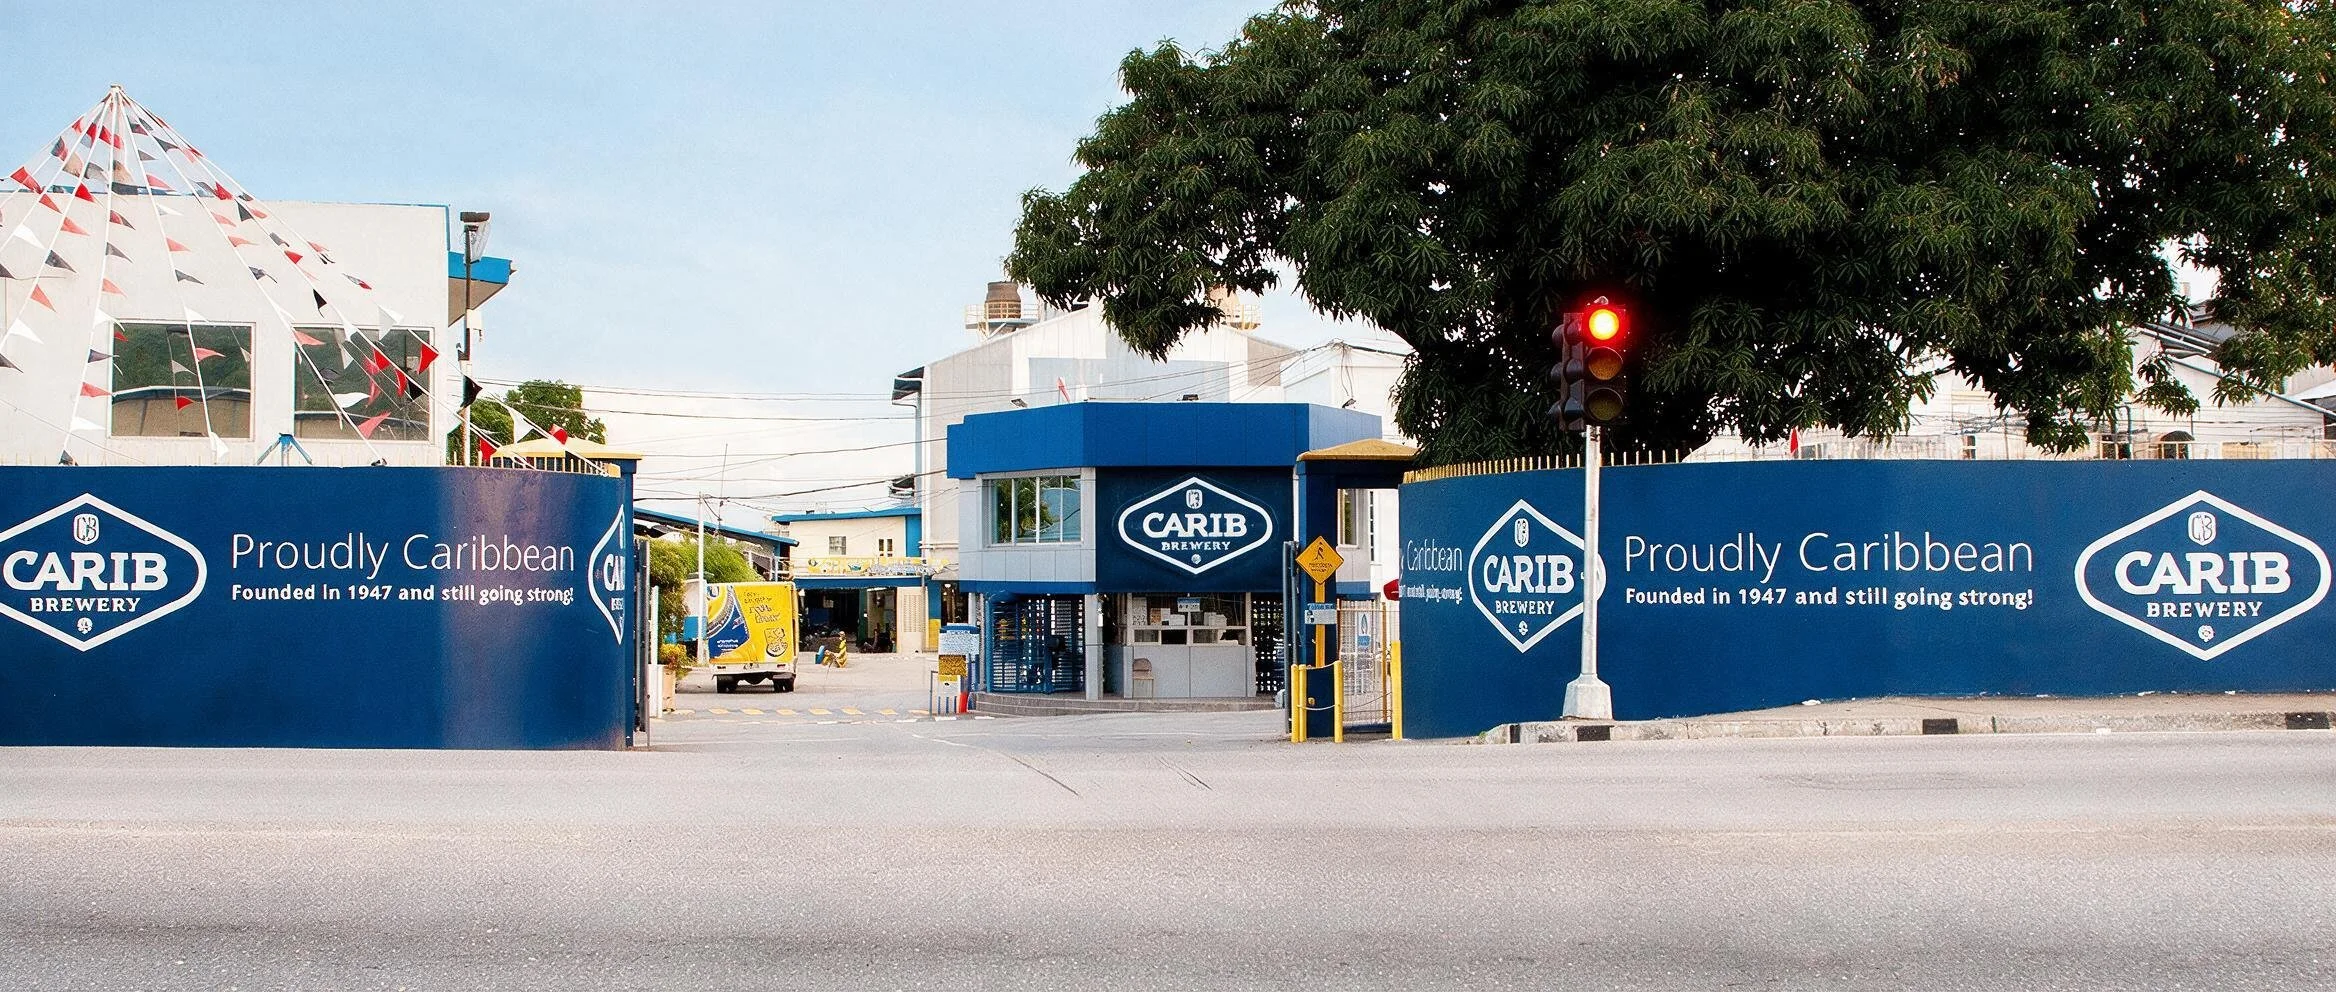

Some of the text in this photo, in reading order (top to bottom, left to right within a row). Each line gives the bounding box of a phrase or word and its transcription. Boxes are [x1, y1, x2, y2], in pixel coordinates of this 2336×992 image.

[1142, 512, 1248, 539] CARIB
[232, 532, 575, 580] Proudly Caribbean
[1161, 541, 1231, 551] BREWERY
[1625, 531, 2033, 584] Proudly Caribbean
[2, 550, 169, 591] CARIB
[1483, 554, 1575, 594] CARIB
[2114, 550, 2291, 595] CARIB
[30, 597, 141, 613] BREWERY
[232, 583, 575, 606] Founded in 1947 and still going strong!
[1494, 600, 1555, 615] BREWERY
[1626, 586, 2033, 611] Founded in 1947 and still going strong!
[2146, 600, 2263, 618] BREWERY
